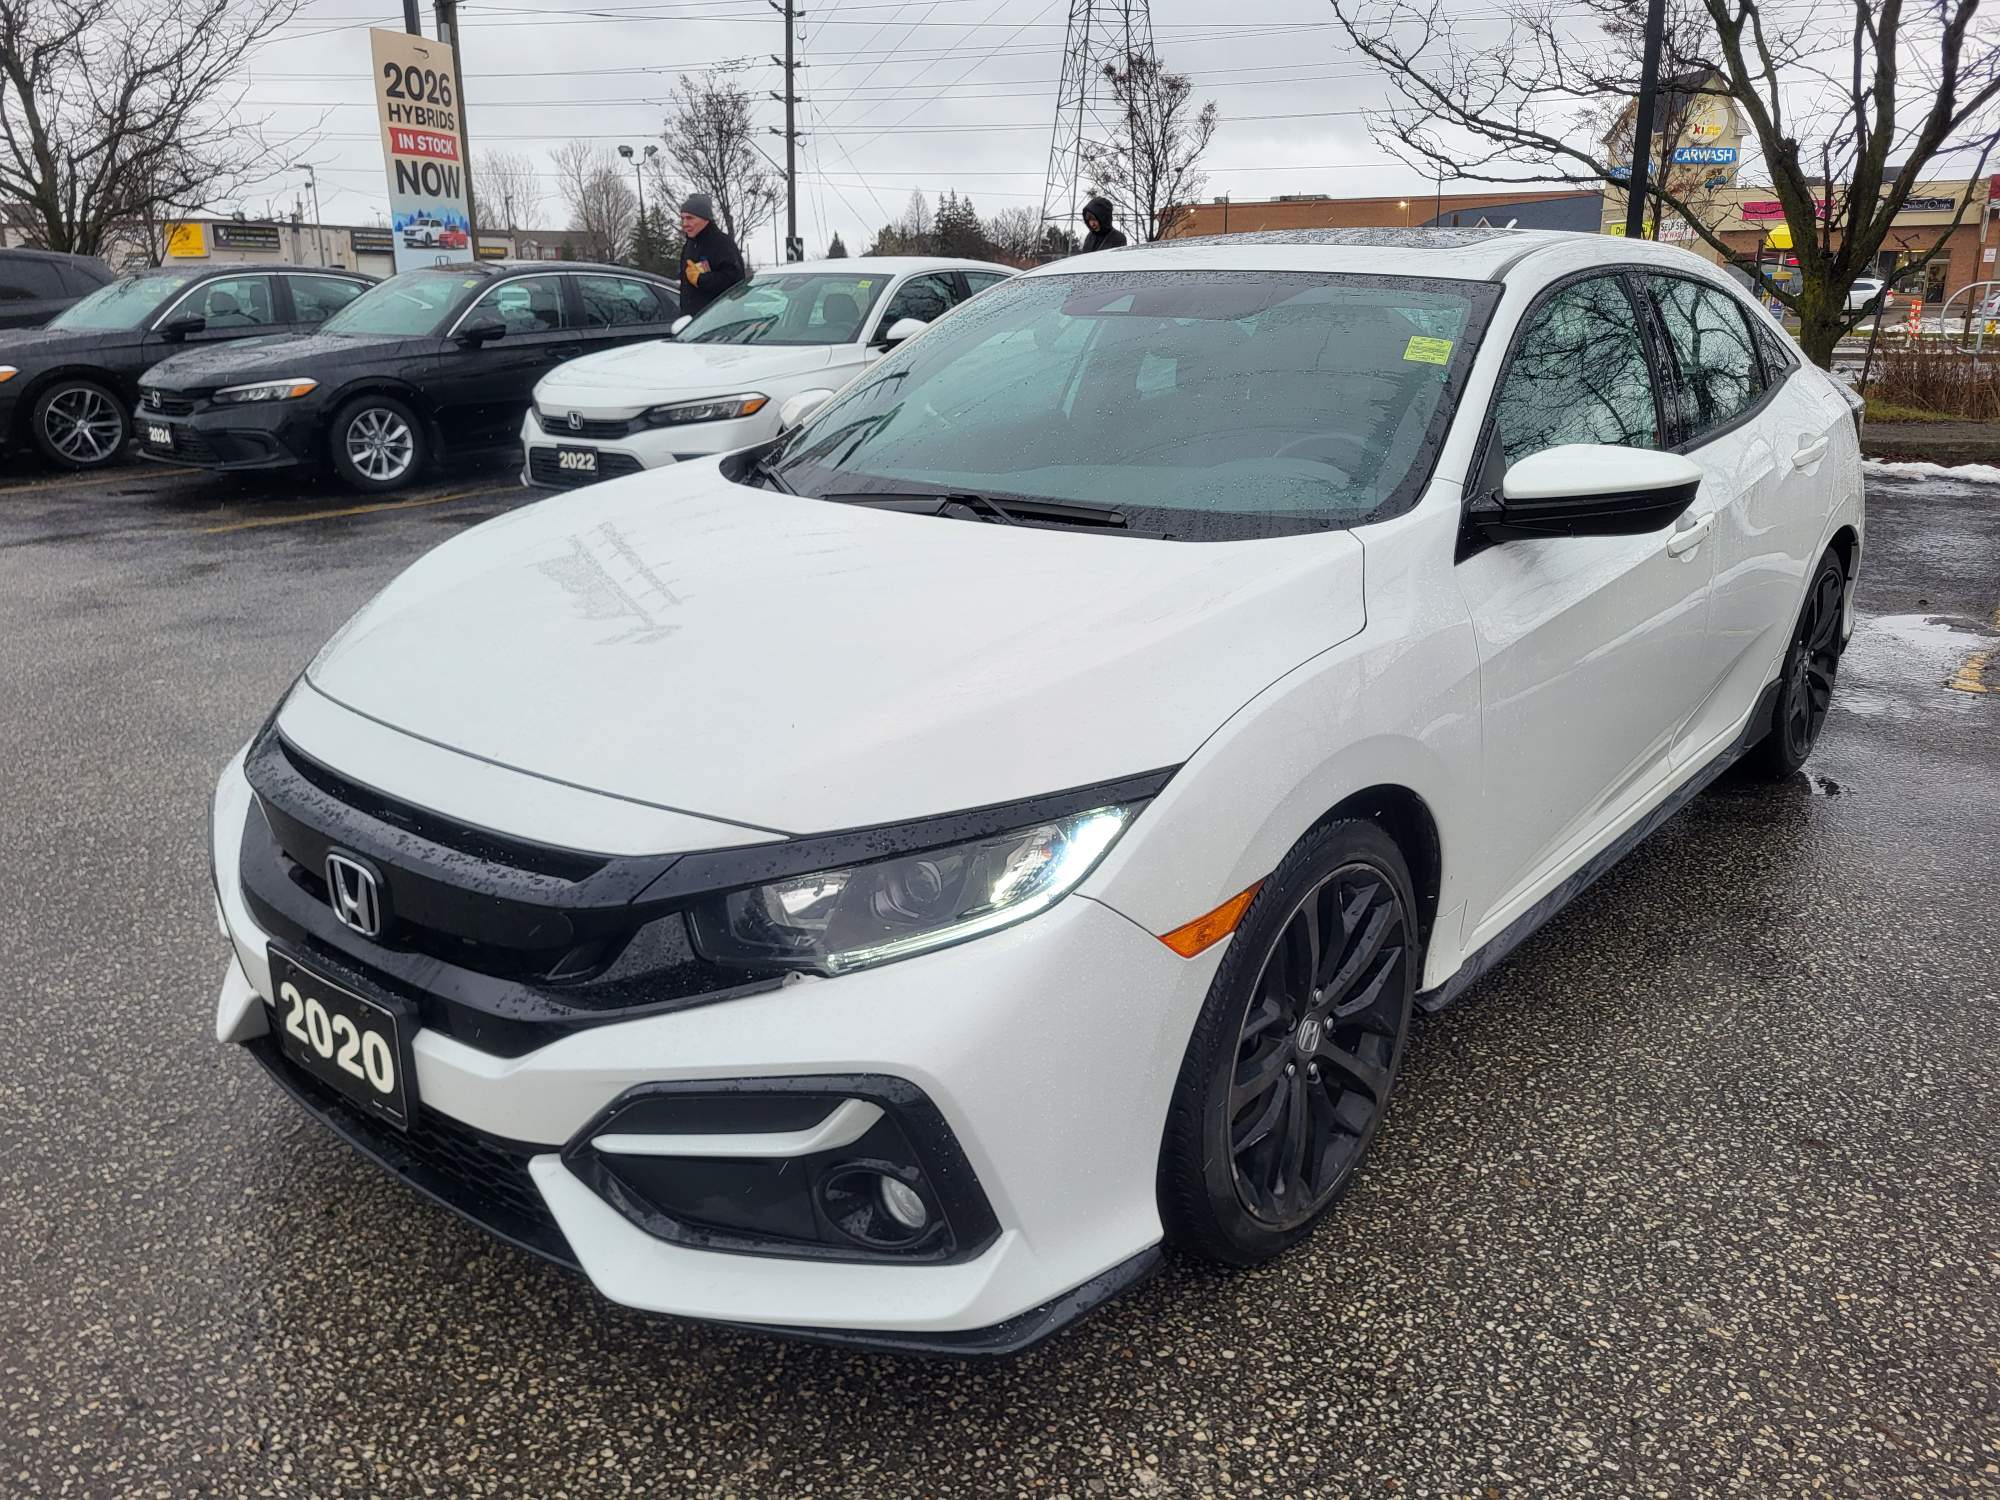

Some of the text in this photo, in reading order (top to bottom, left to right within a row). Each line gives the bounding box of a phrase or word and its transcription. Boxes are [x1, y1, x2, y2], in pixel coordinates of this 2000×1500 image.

[384, 62, 452, 107] 2026
[387, 103, 455, 130] HYBRIDS
[398, 133, 453, 156] IN STOCK
[1674, 149, 1733, 161] CARWASH
[395, 159, 460, 199] NOW
[149, 426, 171, 444] 2024
[559, 451, 596, 470] 2022
[281, 981, 395, 1094] 2020
